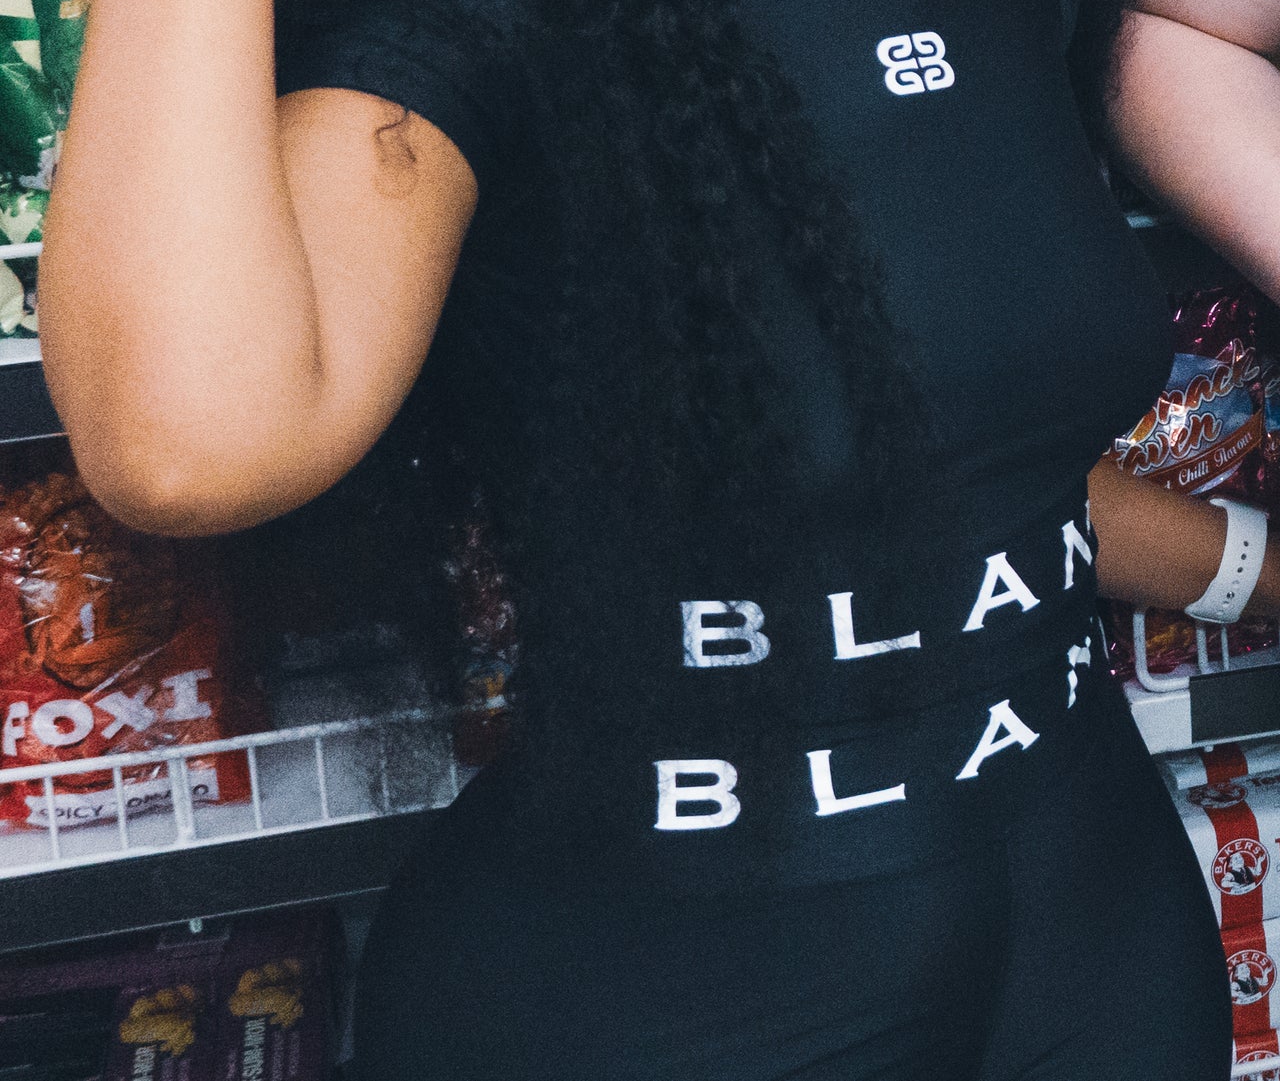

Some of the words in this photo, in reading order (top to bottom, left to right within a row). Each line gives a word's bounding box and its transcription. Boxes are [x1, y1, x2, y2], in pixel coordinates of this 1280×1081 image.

[1178, 460, 1209, 486] Chilli
[1213, 432, 1253, 468] Flavour
[679, 518, 1093, 668] BLAN
[653, 635, 1093, 831] BLA
[1214, 839, 1261, 875] BAKERS
[1229, 951, 1270, 968] KERS
